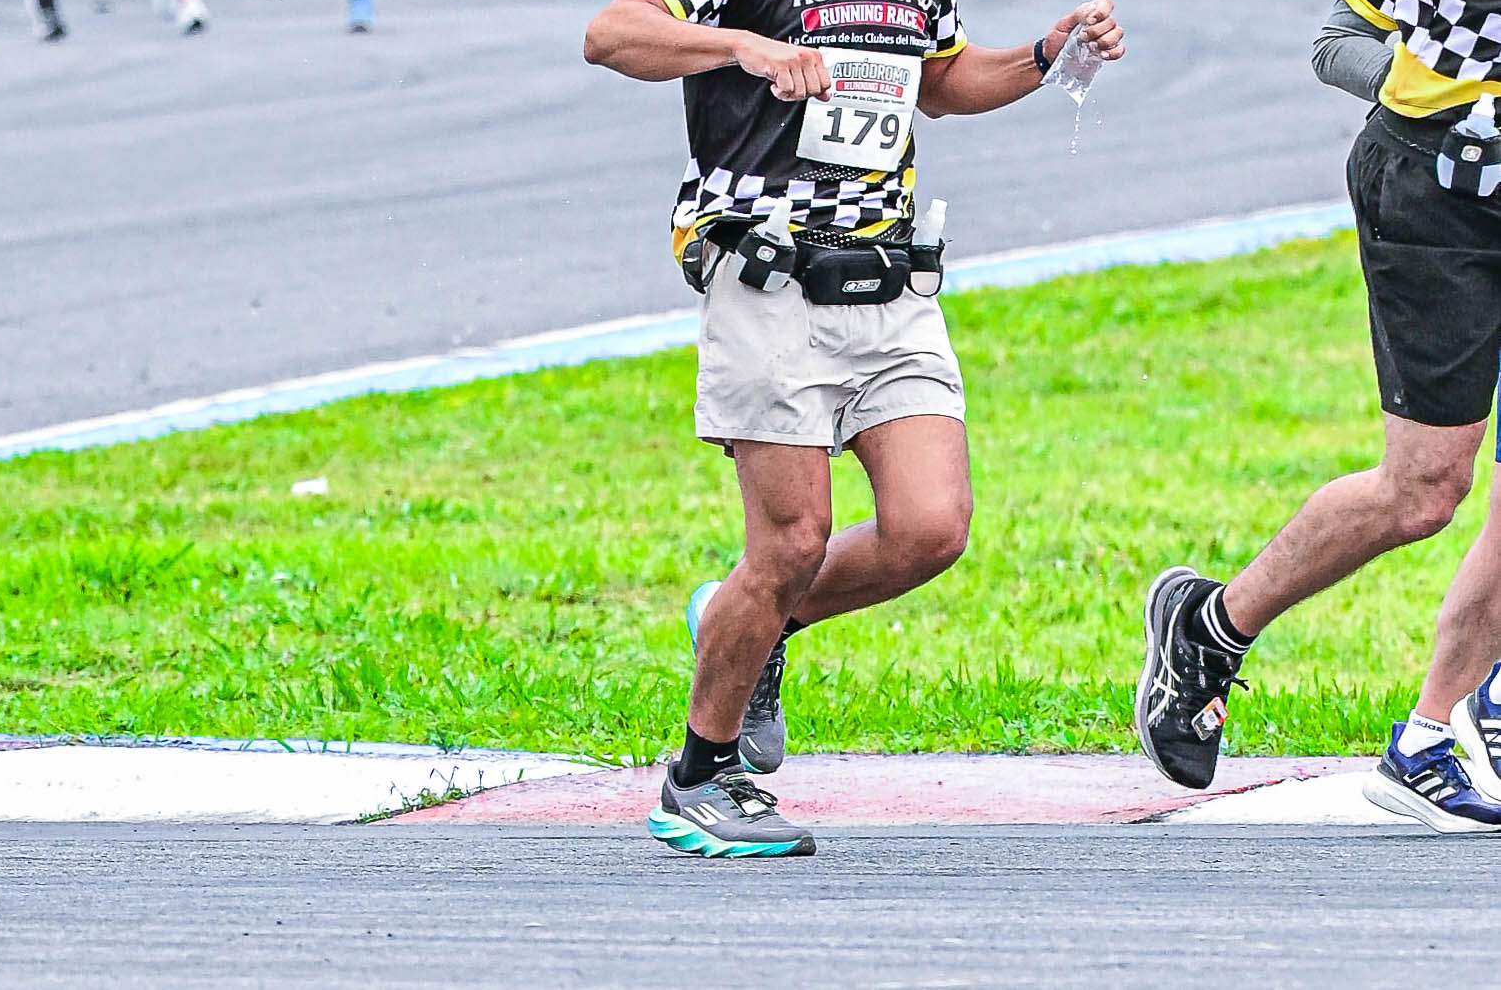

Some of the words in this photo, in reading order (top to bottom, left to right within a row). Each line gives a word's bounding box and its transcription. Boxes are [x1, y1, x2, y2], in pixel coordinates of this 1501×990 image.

[819, 4, 883, 26] RUNNING
[886, 5, 919, 29] RACE
[800, 33, 837, 44] Carrera
[838, 32, 850, 43] de
[851, 32, 863, 43] los
[864, 32, 894, 44] Clubes
[895, 34, 909, 45] del
[832, 57, 911, 85] AUTÓDROMO
[822, 107, 899, 149] 179
